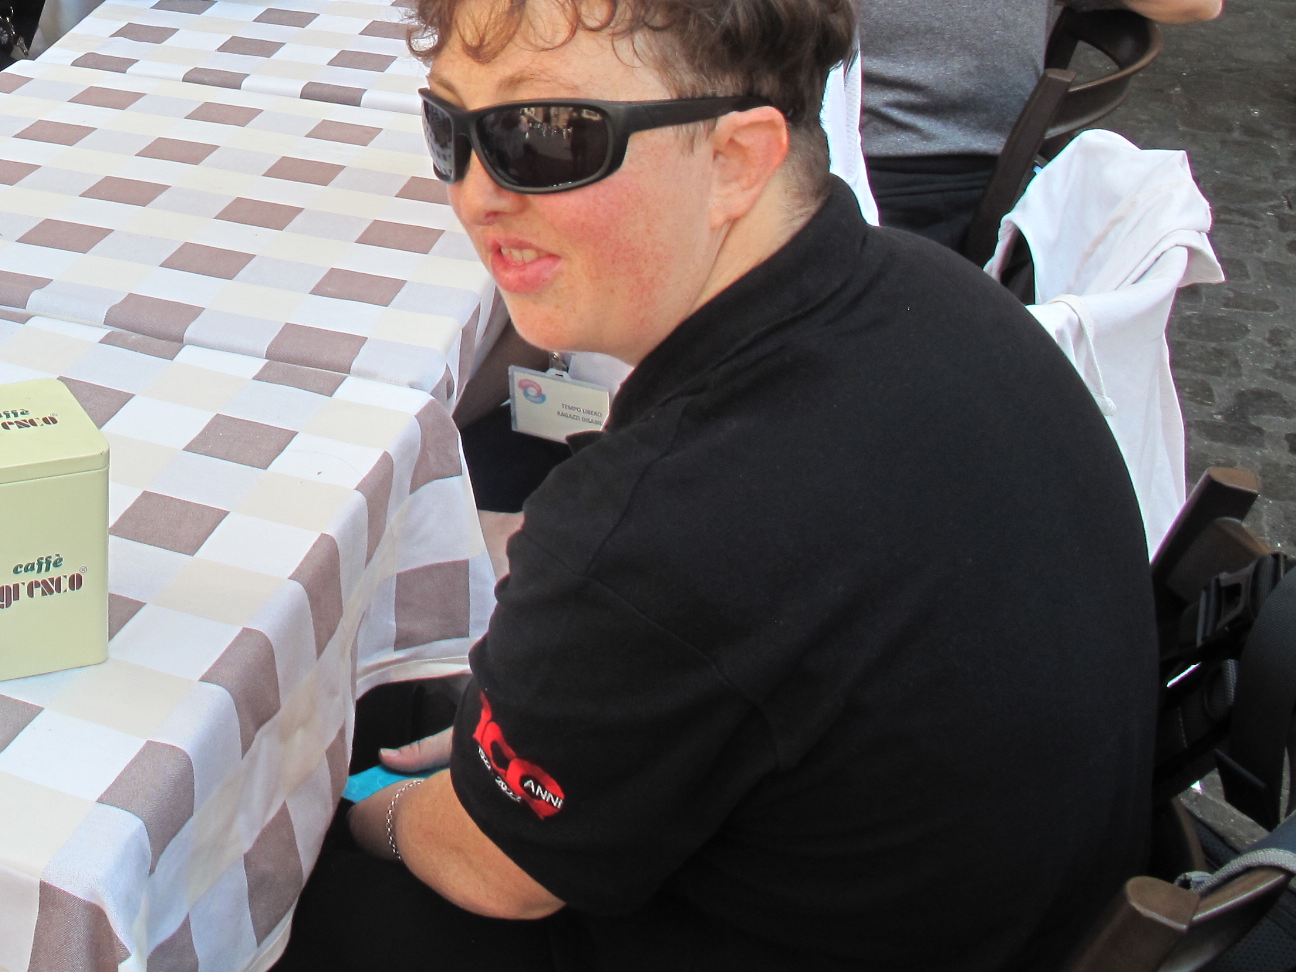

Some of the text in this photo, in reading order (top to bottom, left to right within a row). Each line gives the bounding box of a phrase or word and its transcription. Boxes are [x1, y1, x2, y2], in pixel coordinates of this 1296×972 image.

[556, 411, 580, 421] RAGAZZI
[561, 403, 603, 418] TEMPO LIBERO
[12, 554, 63, 575] caffè
[524, 779, 563, 809] ANNI
